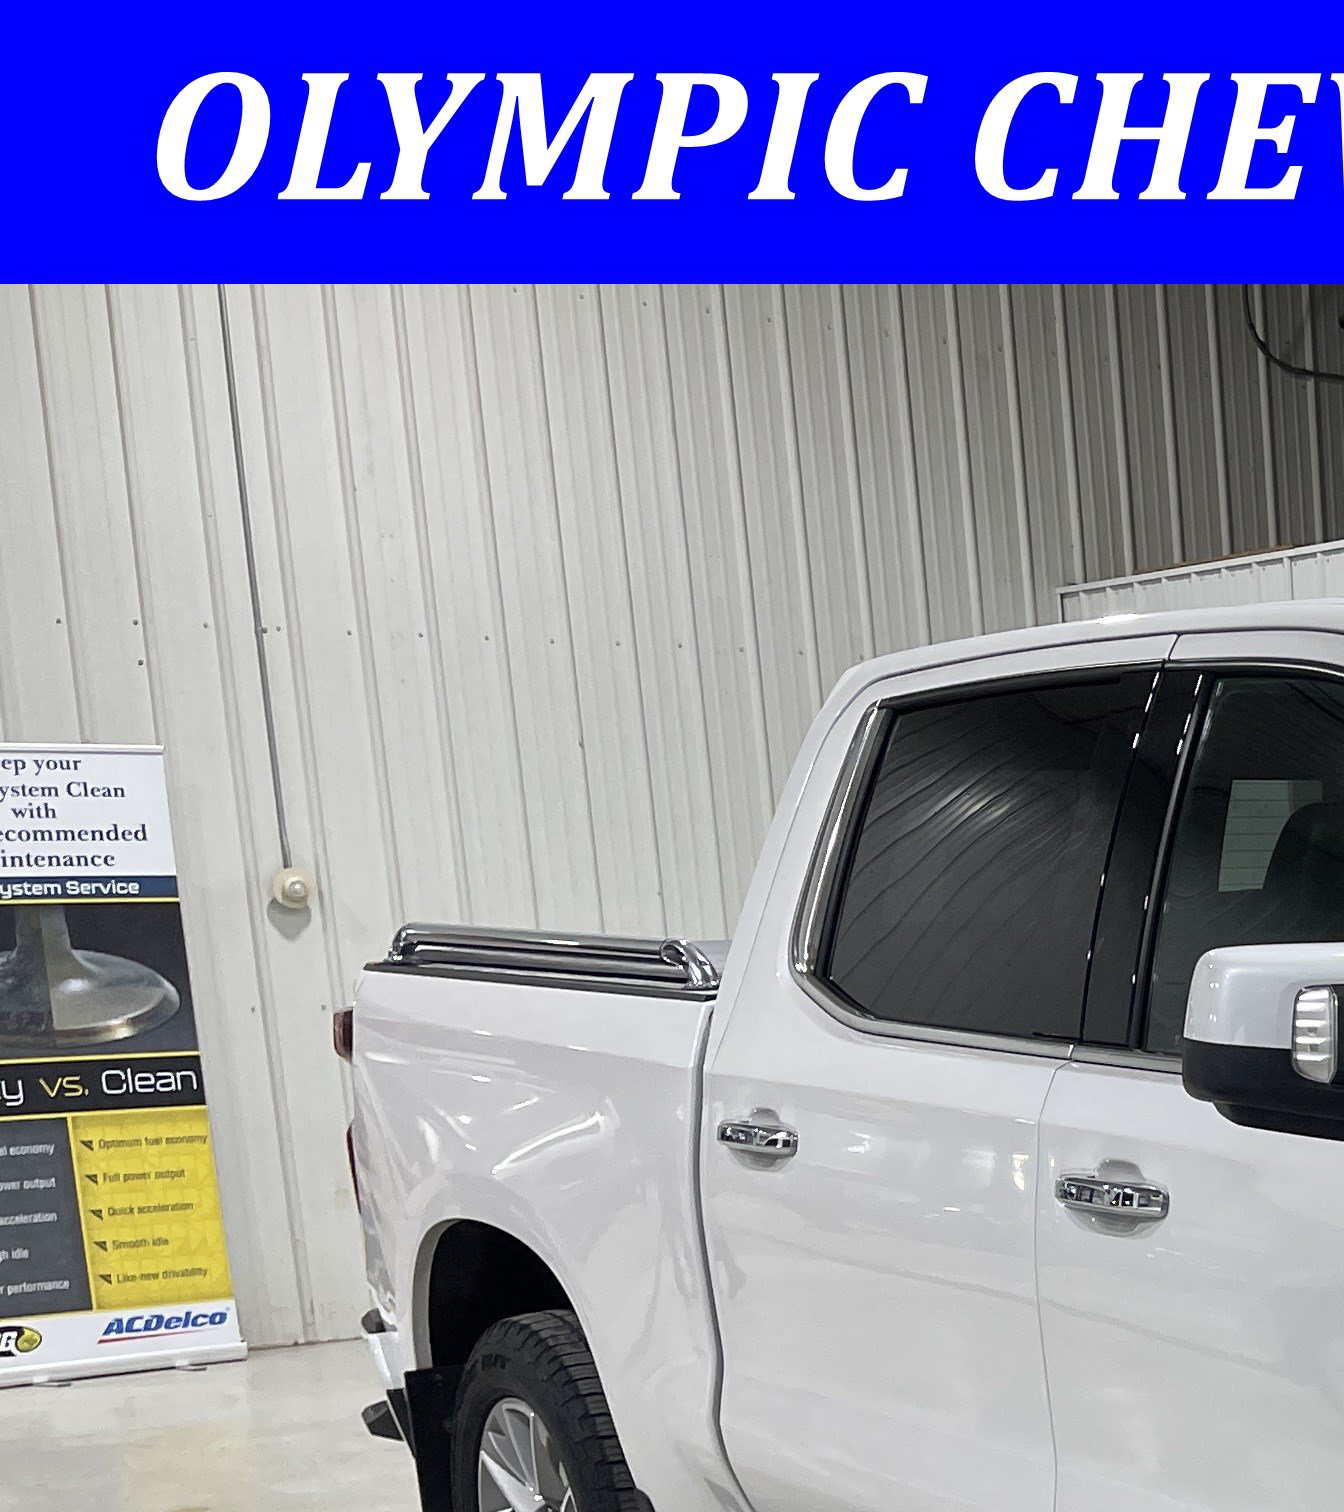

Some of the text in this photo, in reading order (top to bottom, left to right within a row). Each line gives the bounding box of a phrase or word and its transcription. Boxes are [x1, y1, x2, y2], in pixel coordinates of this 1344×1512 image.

[33, 758, 82, 777] your
[66, 781, 125, 798] Clean
[11, 802, 57, 819] with
[65, 879, 140, 897] Service
[39, 1075, 89, 1098] vs.
[101, 1067, 198, 1095] Clean
[102, 1310, 228, 1336] ACDelco
